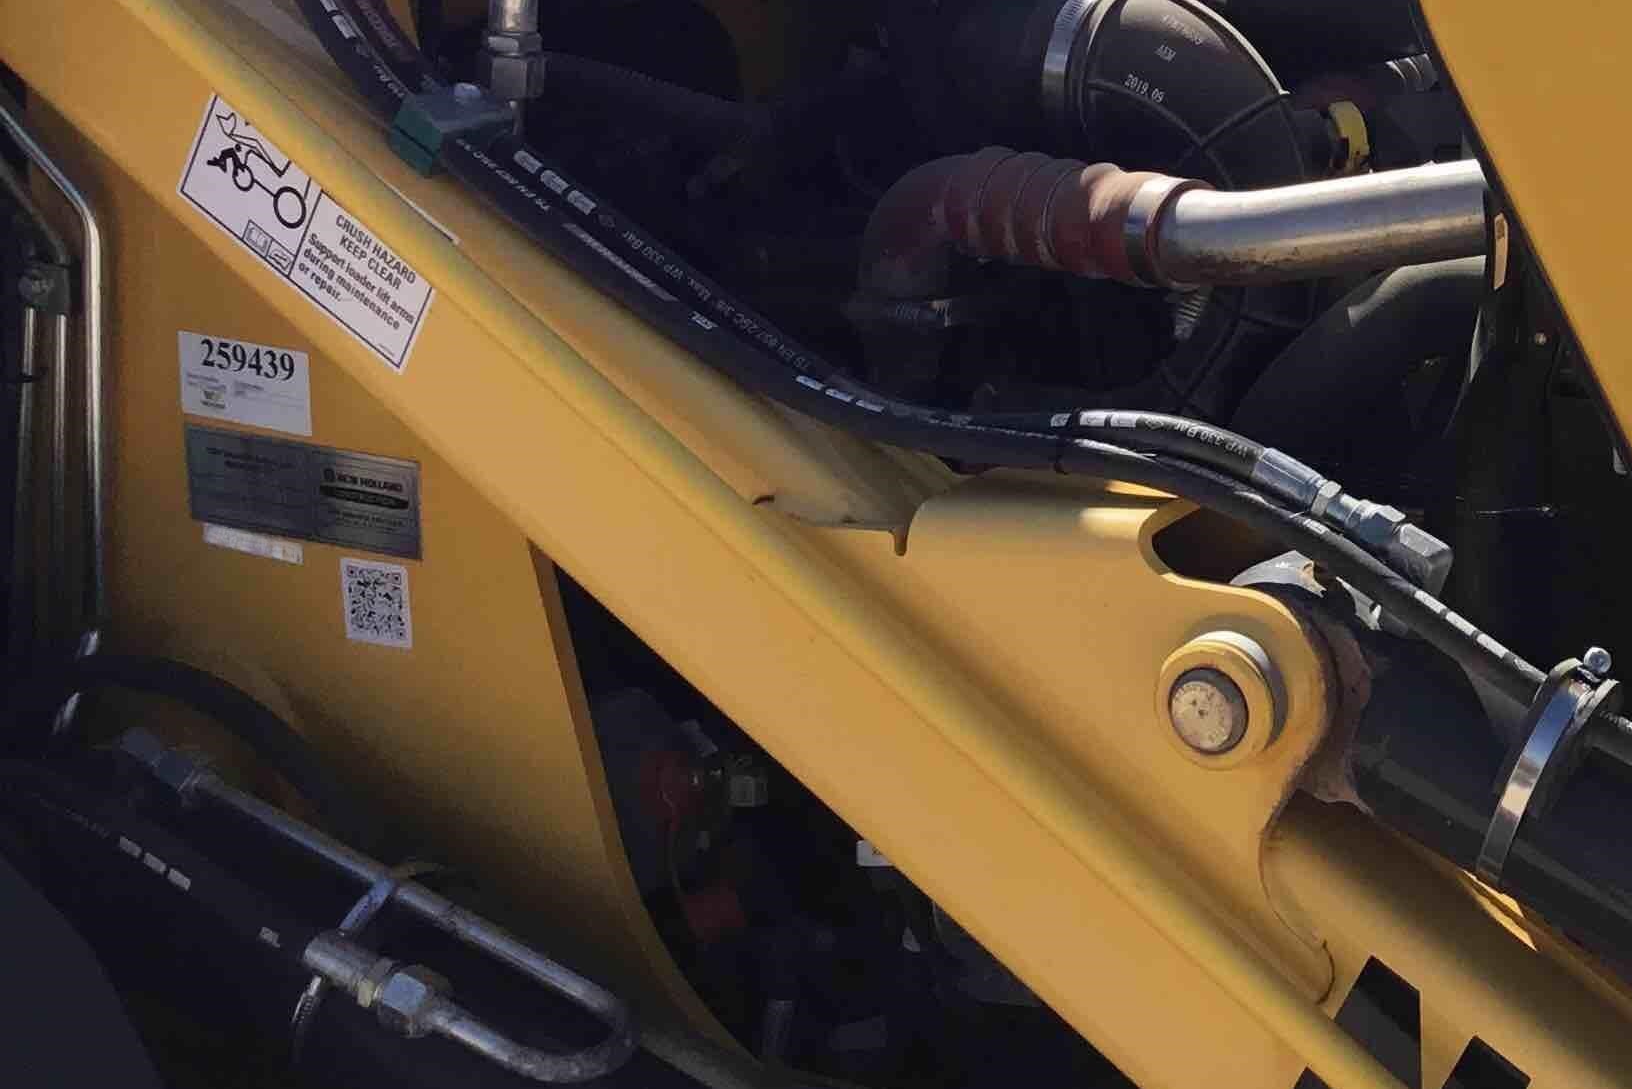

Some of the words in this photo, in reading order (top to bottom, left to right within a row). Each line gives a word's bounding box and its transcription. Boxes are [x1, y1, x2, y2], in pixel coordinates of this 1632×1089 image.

[308, 232, 346, 269] Support
[345, 262, 377, 292] loader
[376, 286, 391, 305] lift
[390, 300, 416, 325] arms
[335, 214, 373, 249] CRUSH
[372, 244, 416, 284] HAZARD
[339, 235, 368, 261] KEEP
[367, 257, 402, 290] CLEAR
[298, 262, 311, 274] or
[310, 272, 342, 302] repair.
[303, 247, 336, 281] during
[335, 275, 400, 330] maintenance
[200, 338, 295, 381] 259439
